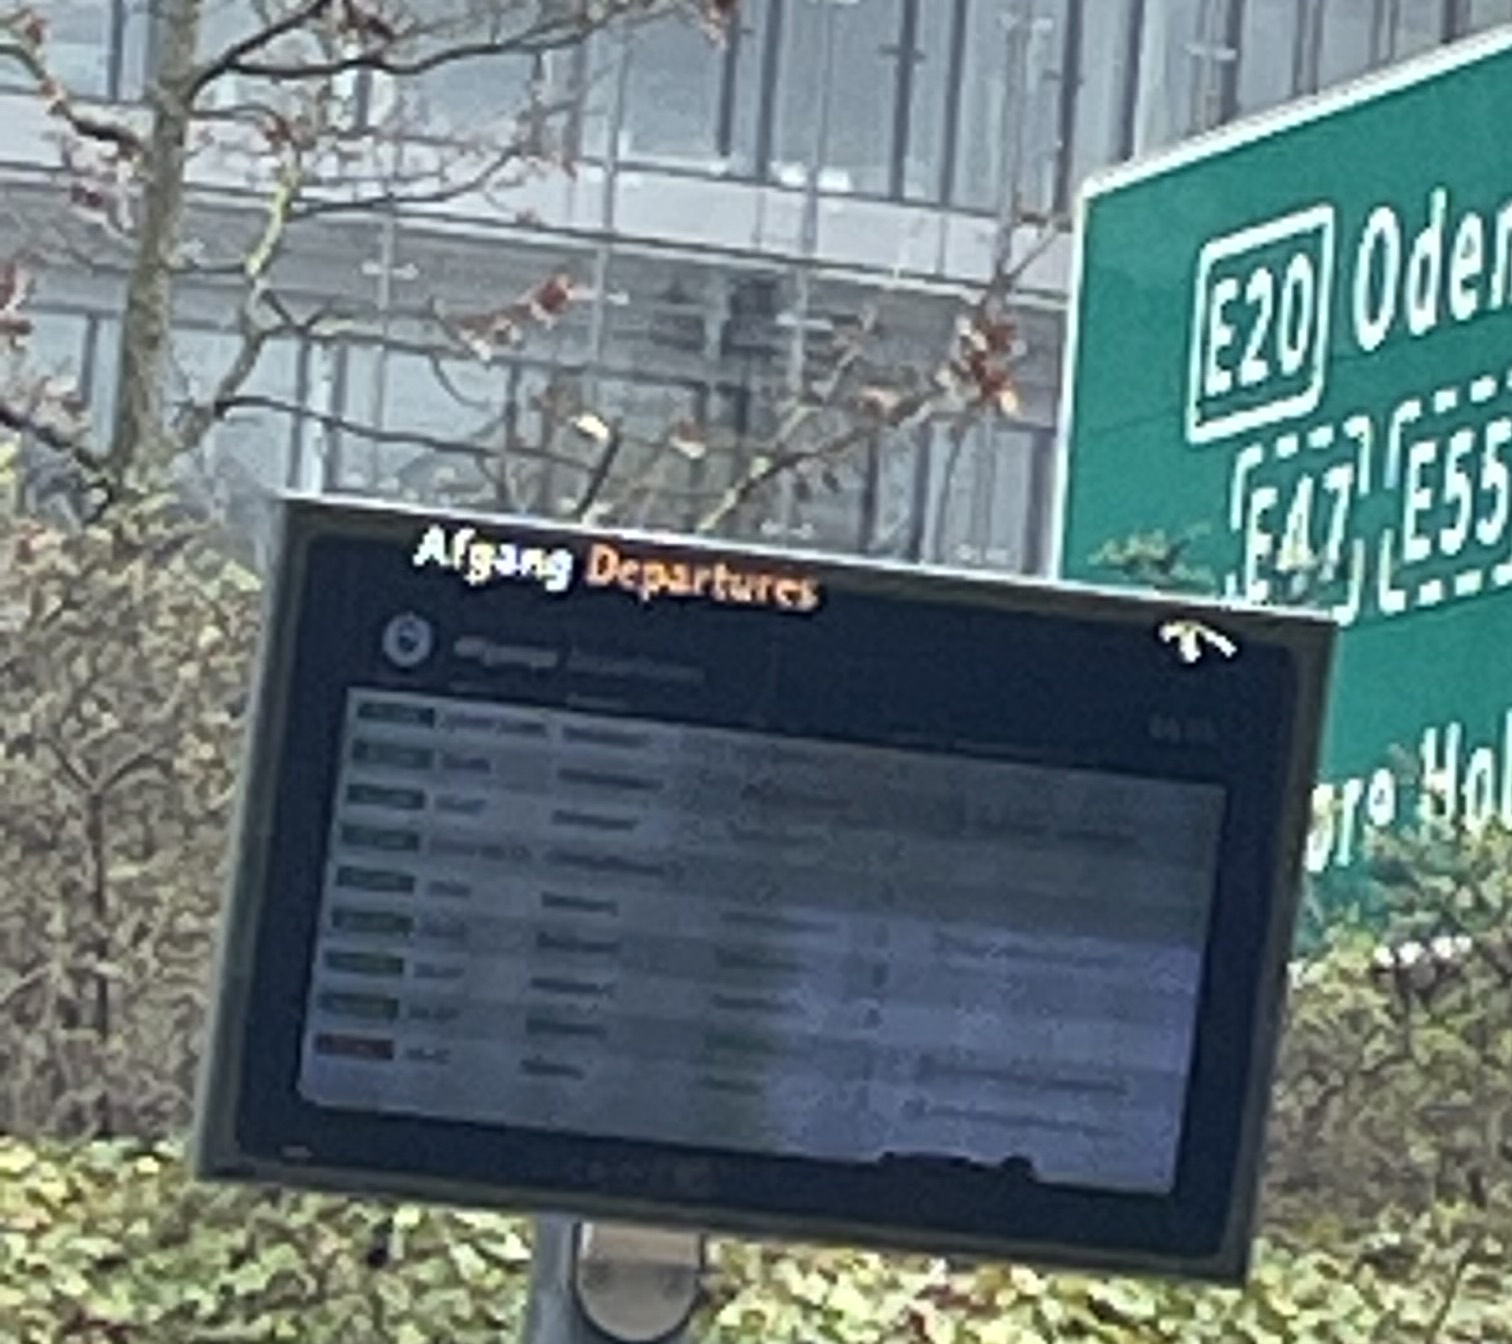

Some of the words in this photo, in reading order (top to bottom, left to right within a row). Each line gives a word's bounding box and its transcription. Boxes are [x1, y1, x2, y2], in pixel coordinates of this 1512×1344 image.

[1205, 253, 1314, 397] E20
[412, 524, 574, 592] Afgang
[585, 542, 821, 612] Departures
[1246, 463, 1354, 599] E47
[1404, 417, 1512, 563] E55
